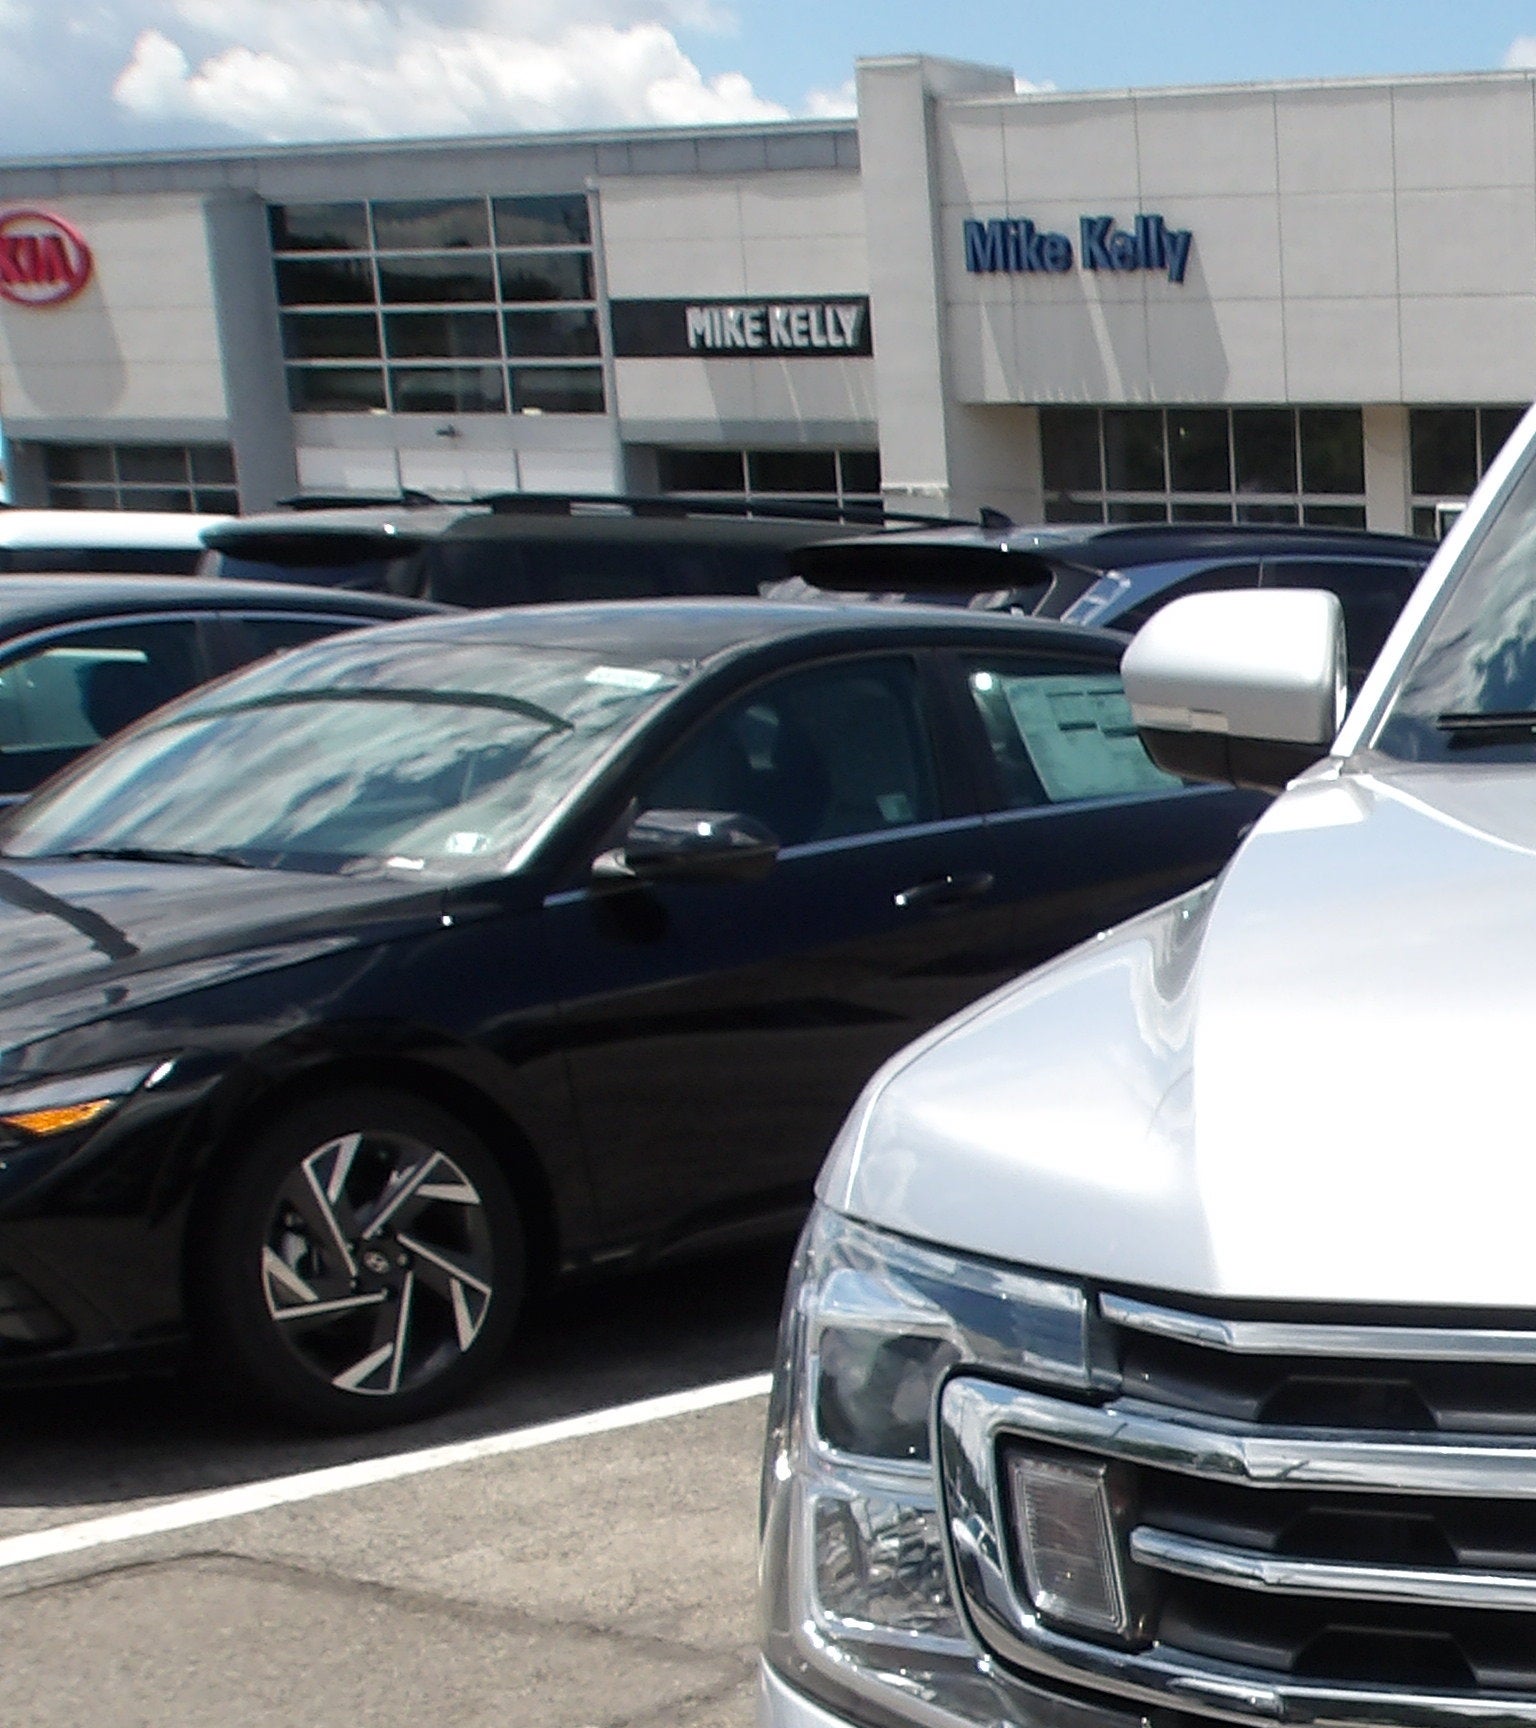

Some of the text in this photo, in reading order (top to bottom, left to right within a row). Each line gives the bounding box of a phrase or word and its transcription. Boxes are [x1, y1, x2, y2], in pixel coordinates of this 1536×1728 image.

[963, 213, 1193, 284] Mike Kelly
[685, 304, 864, 349] MIKE KELLY
